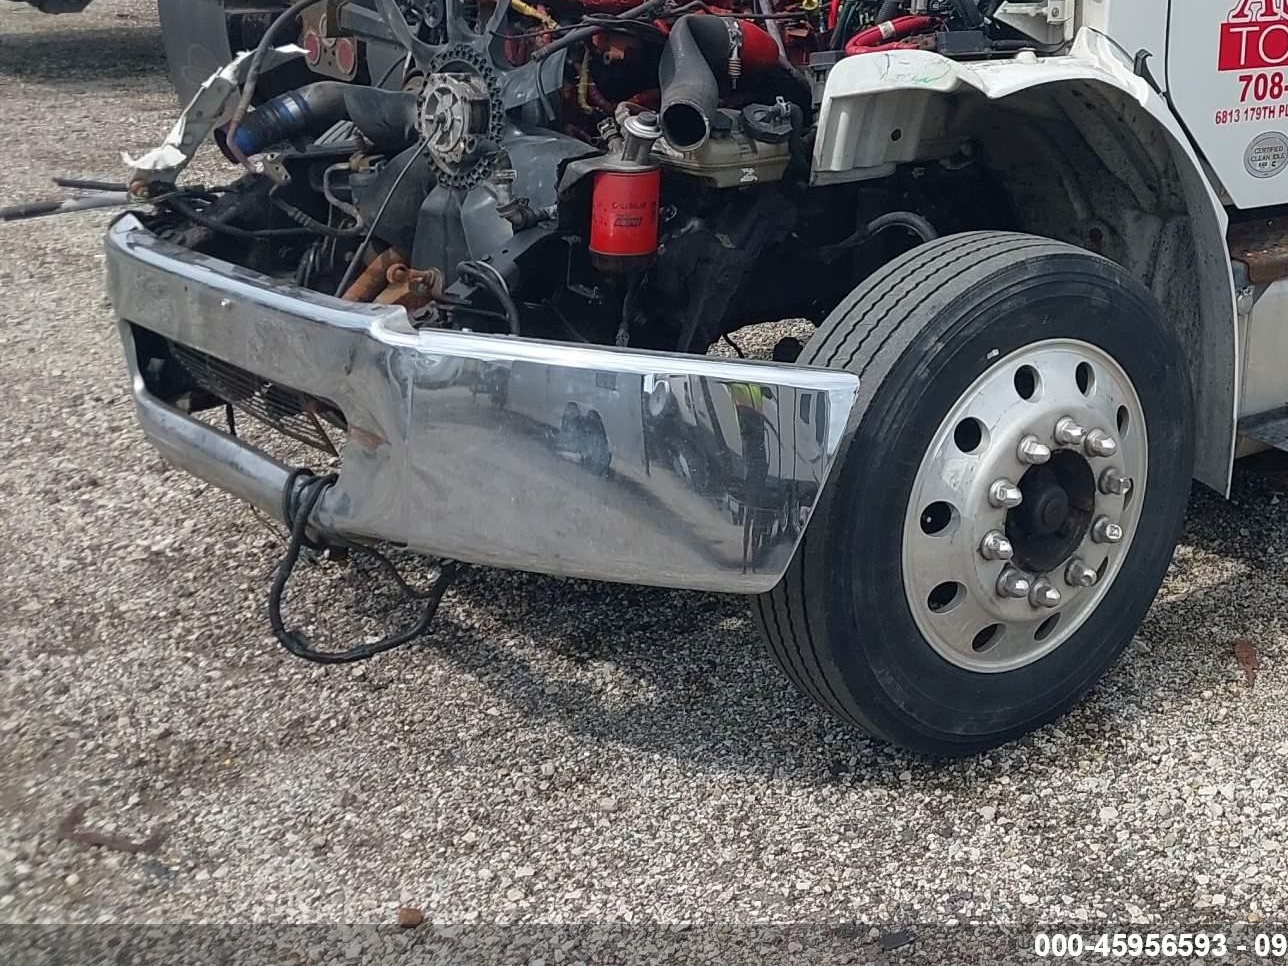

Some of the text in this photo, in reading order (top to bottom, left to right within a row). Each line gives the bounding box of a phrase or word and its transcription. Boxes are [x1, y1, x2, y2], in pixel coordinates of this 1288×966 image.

[1215, 109, 1240, 124] 6813
[1244, 105, 1275, 122] 179TH
[1254, 145, 1284, 154] CERTIFIED
[1250, 152, 1286, 162] CLEAN IDLE
